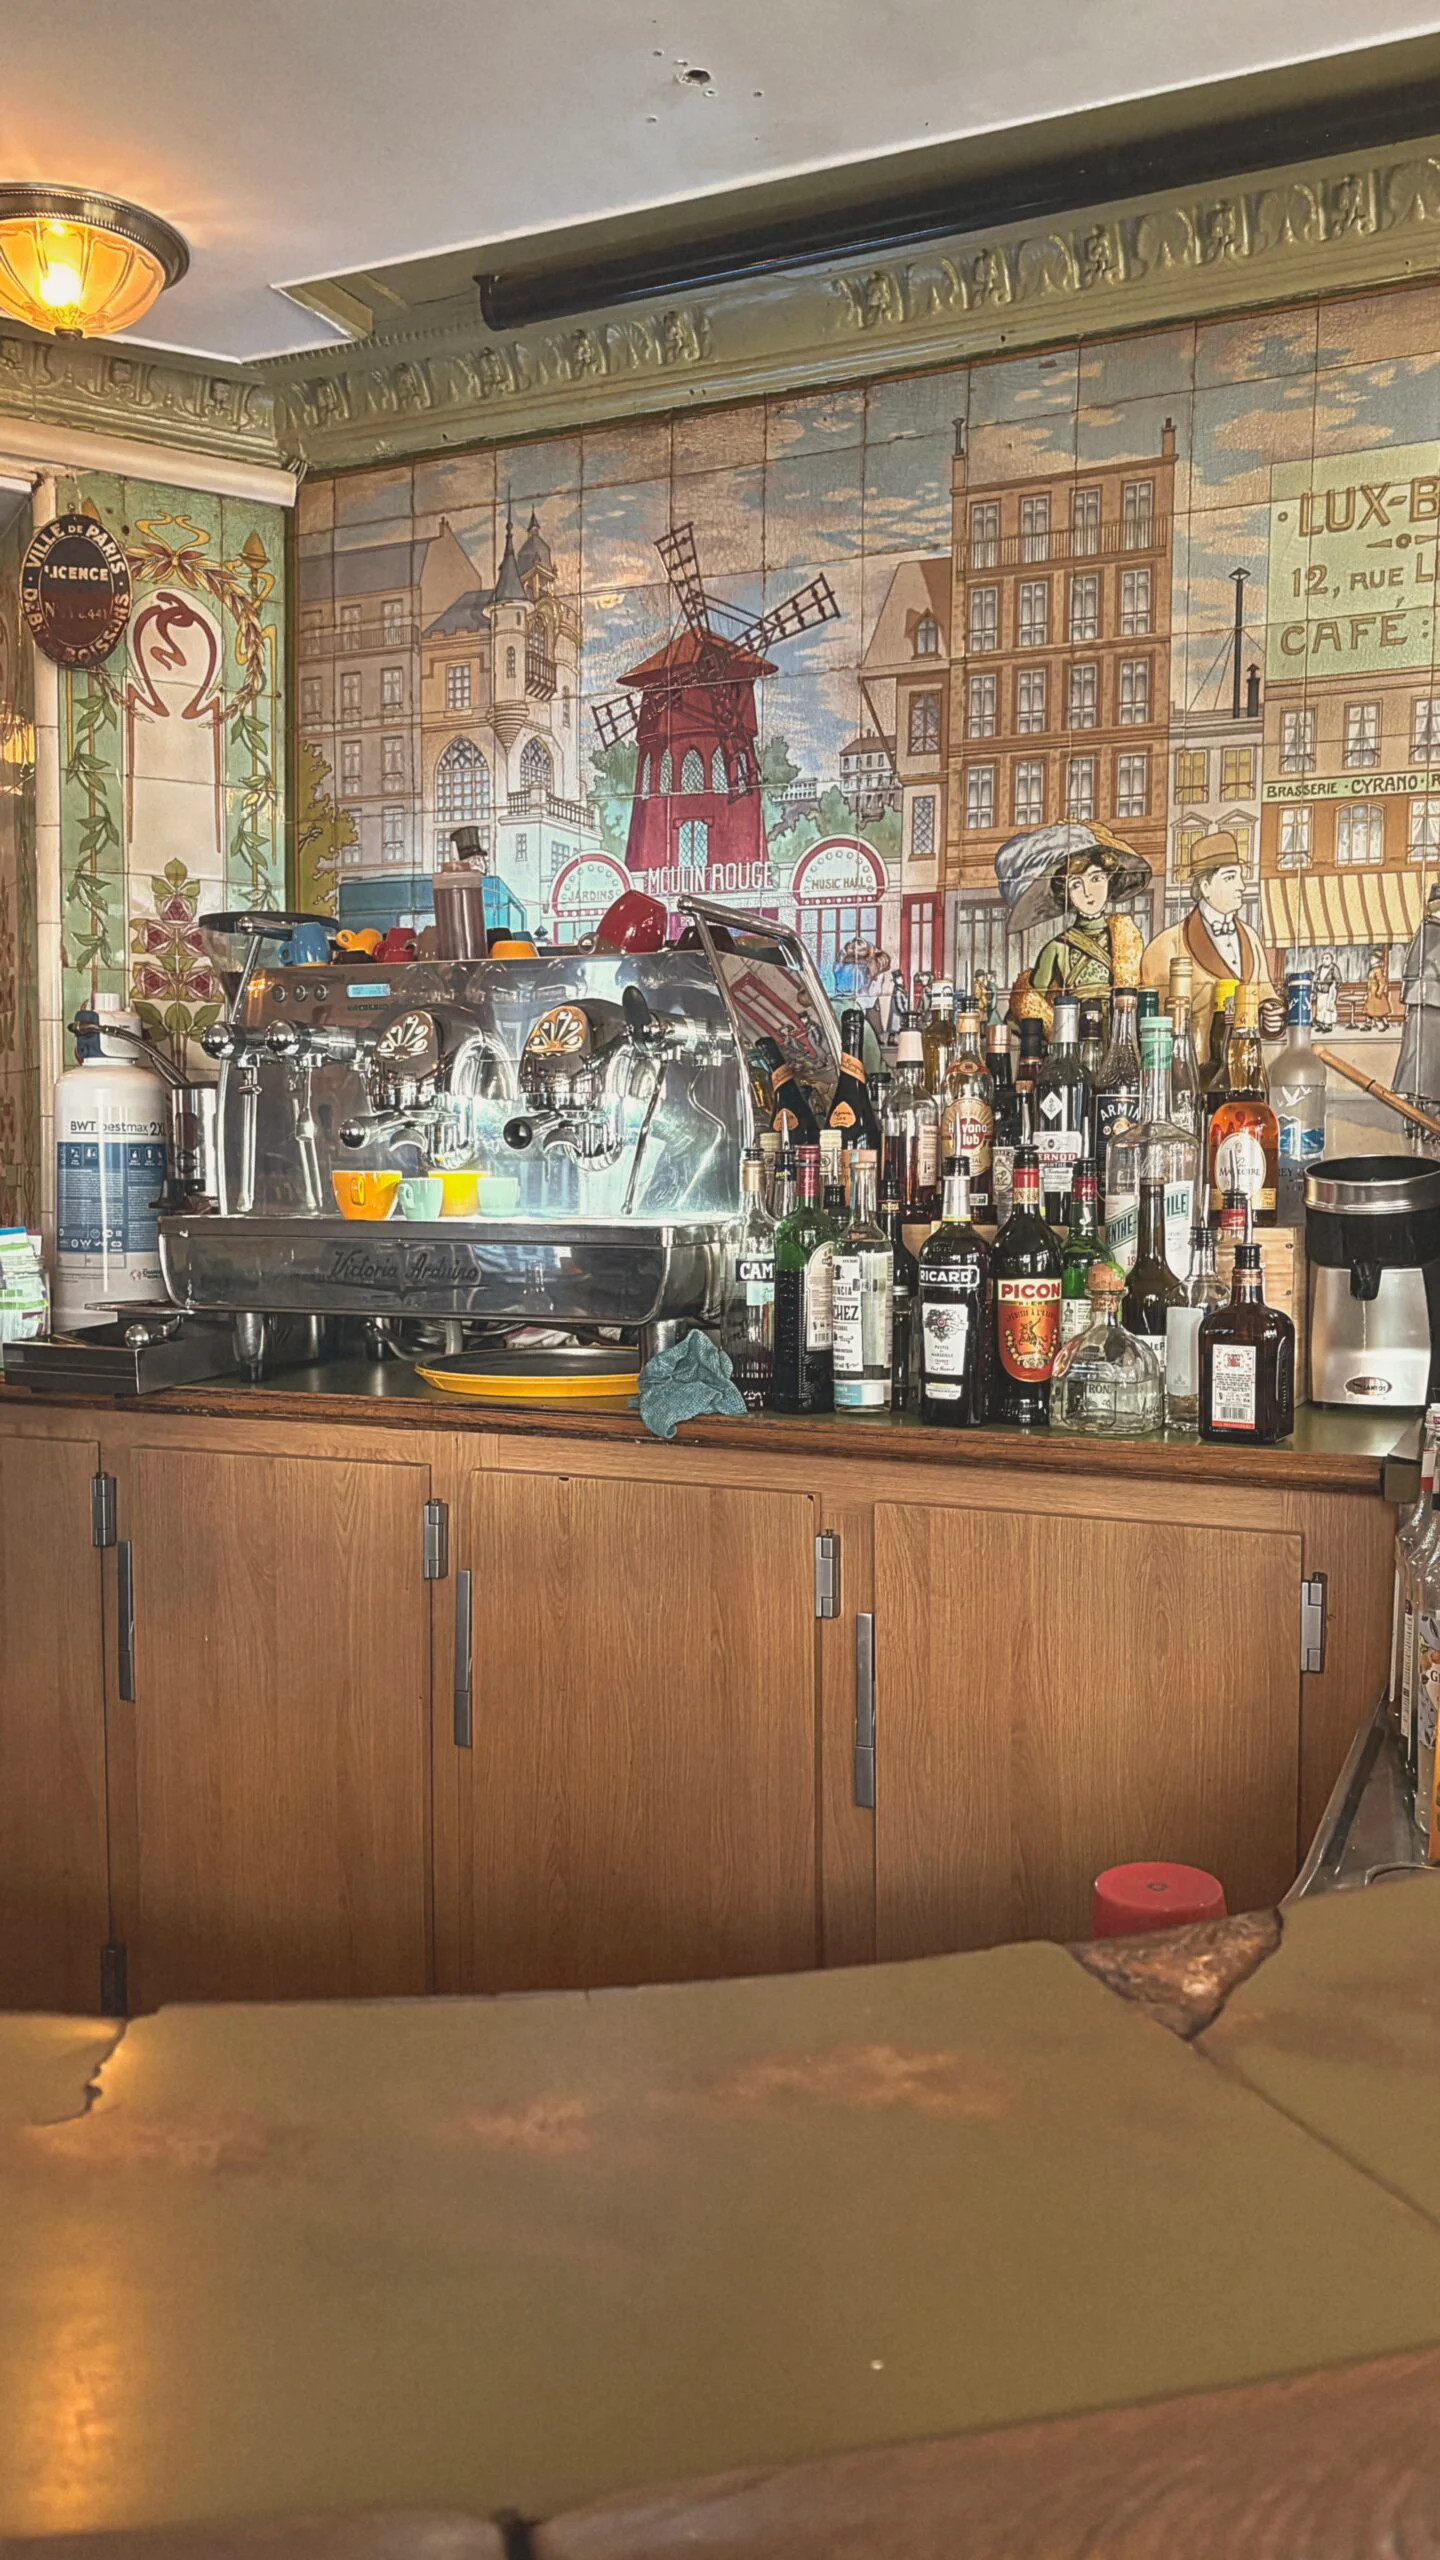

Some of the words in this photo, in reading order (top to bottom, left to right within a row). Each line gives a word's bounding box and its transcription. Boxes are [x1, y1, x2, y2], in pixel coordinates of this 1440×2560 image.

[1299, 476, 1440, 537] LUX-B
[25, 523, 65, 568] VILLE
[68, 525, 83, 534] DE
[85, 524, 126, 574] PARIS
[44, 564, 109, 581] LICENCE
[1350, 567, 1404, 591] RUE
[1267, 782, 1338, 798] BRASSERIE
[1351, 775, 1418, 794] CYRANO
[648, 866, 706, 895] MOULIN
[711, 860, 775, 890] ROUGE
[811, 876, 844, 890] MUSIC
[846, 876, 868, 890] HALL
[568, 888, 616, 901] JARDINS
[70, 1121, 96, 1131] BWT
[948, 1121, 988, 1133] Hvana
[1166, 1193, 1187, 1217] ILLE
[328, 1249, 398, 1279] Victoria
[405, 1252, 479, 1280] Arduino
[740, 1262, 774, 1280] CAM
[920, 1271, 972, 1283] RICARD
[1001, 1282, 1060, 1299] PICON
[833, 1305, 859, 1321] CHEZ
